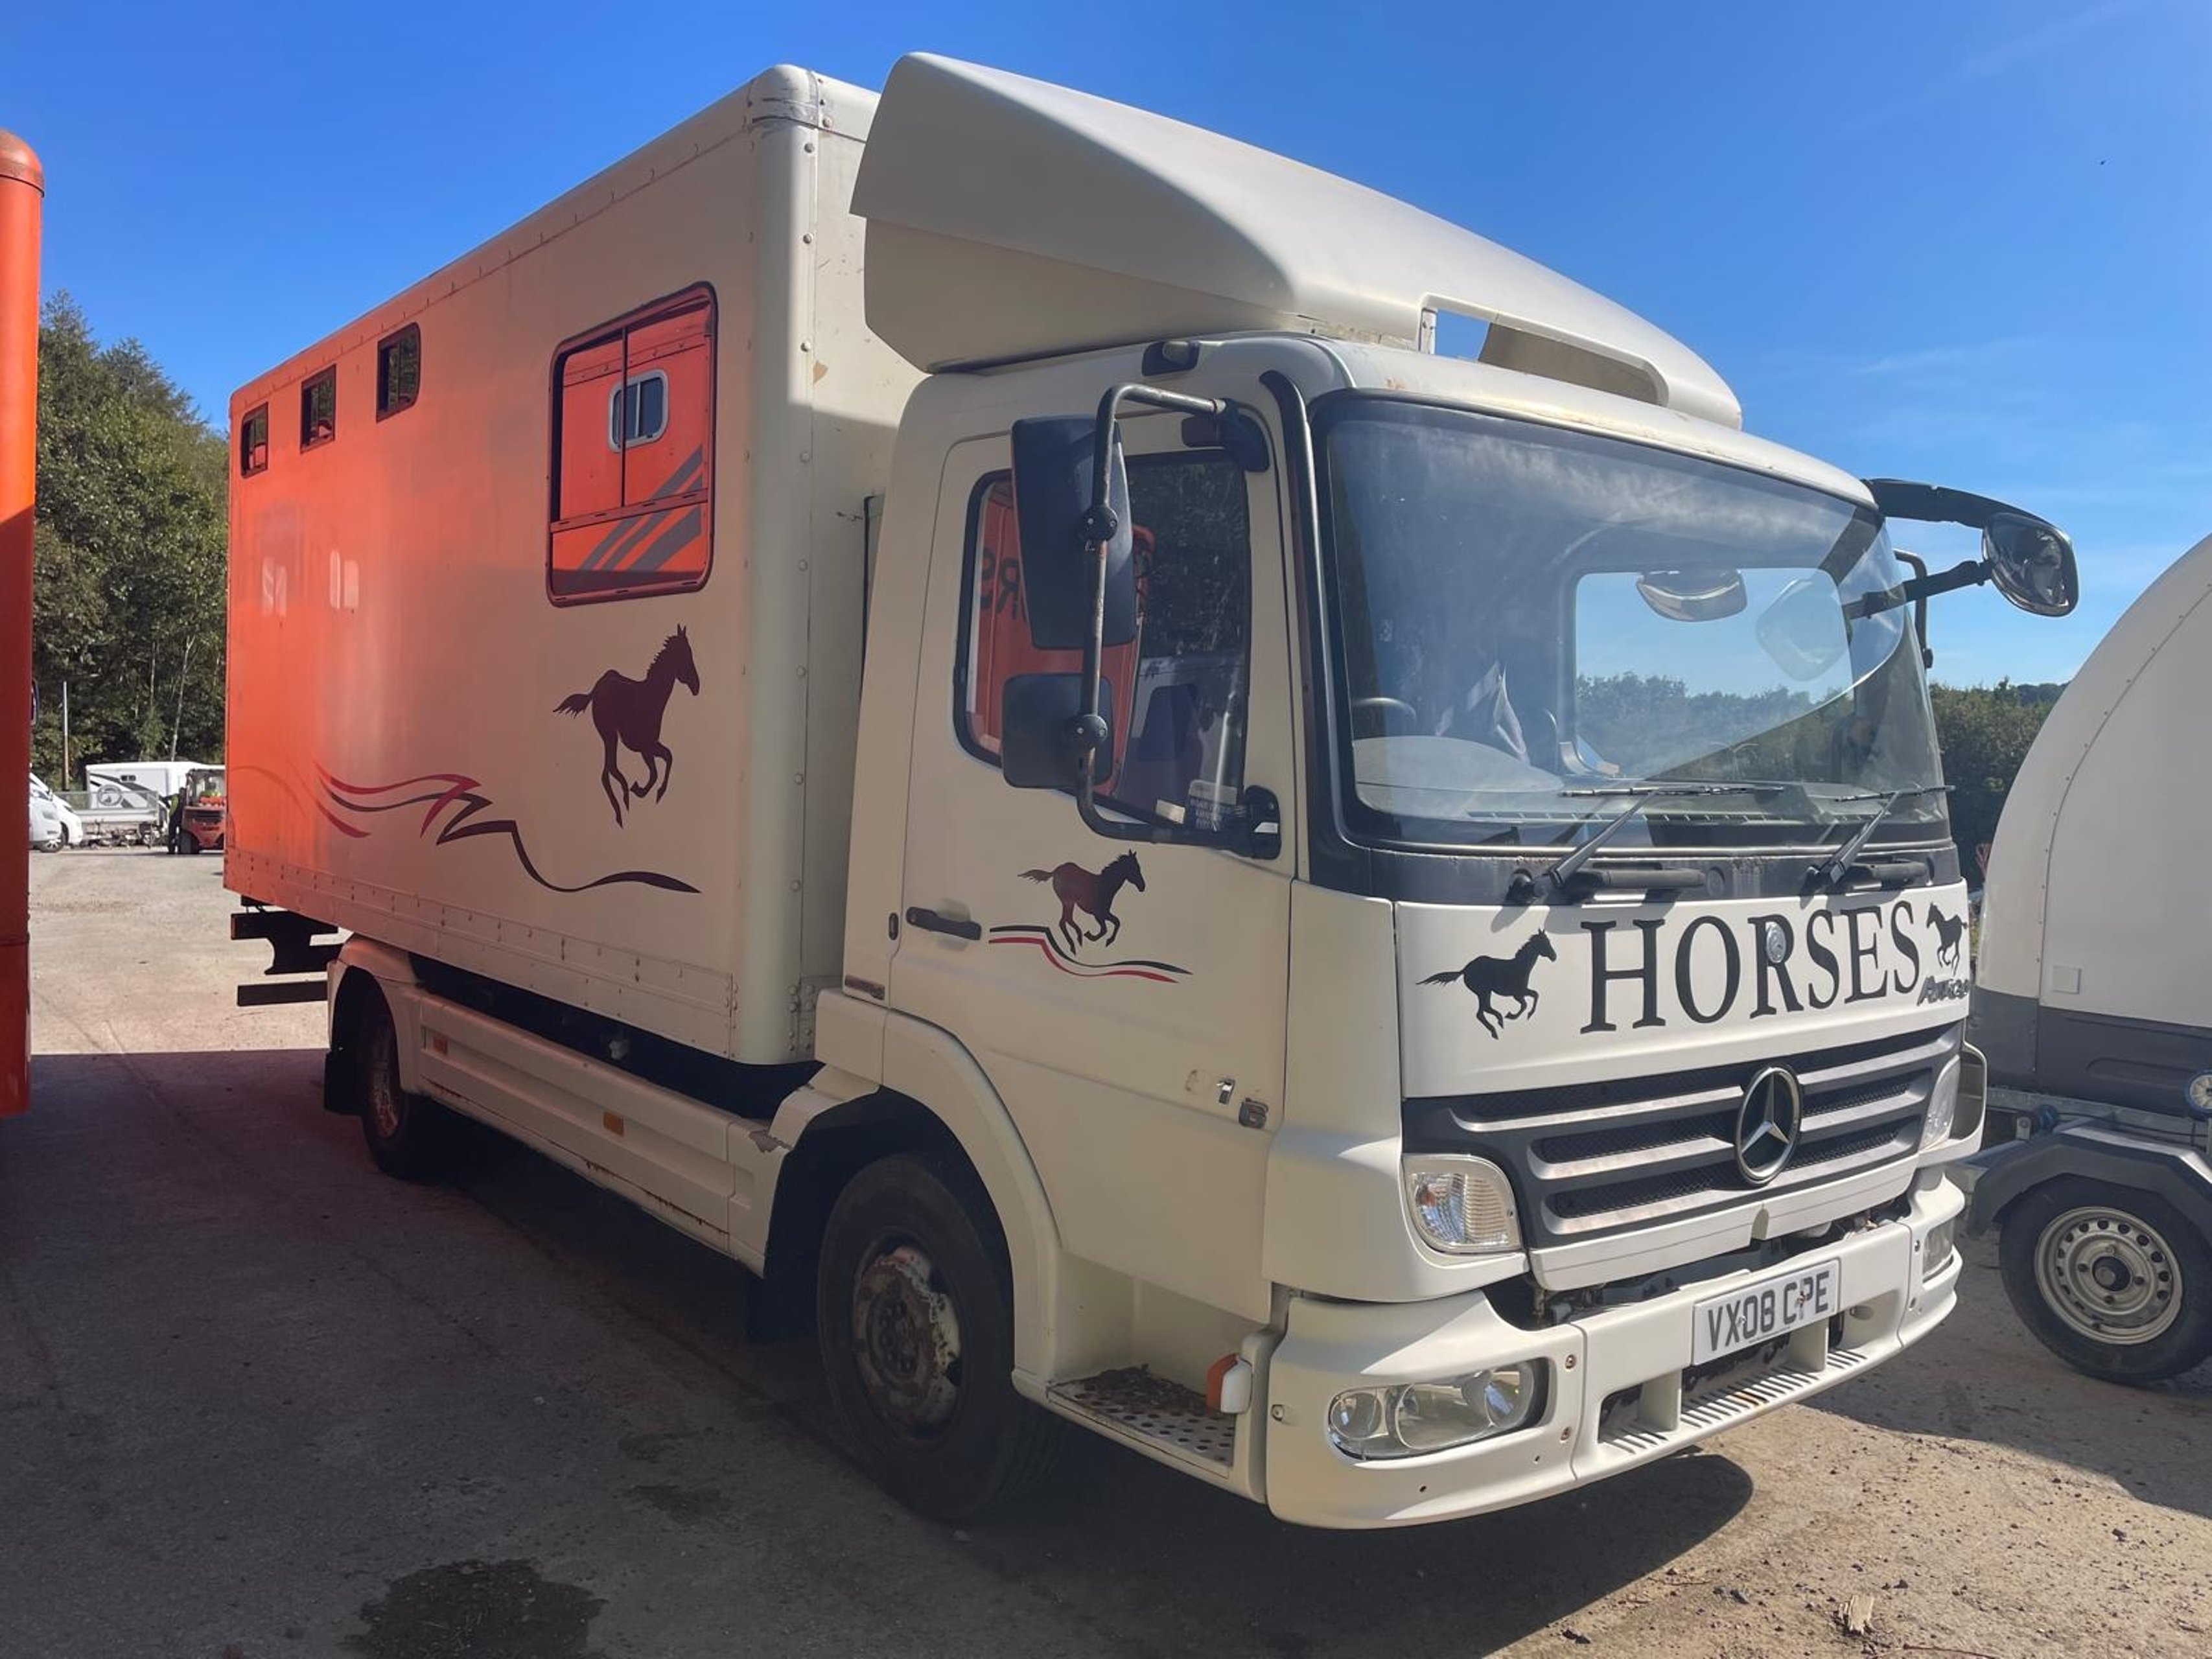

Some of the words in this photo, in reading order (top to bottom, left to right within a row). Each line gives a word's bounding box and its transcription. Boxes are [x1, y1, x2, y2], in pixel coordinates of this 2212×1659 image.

[1580, 900, 1920, 1035] HORSES
[1708, 1290, 1775, 1351] VX08
[1783, 1271, 1830, 1325] CPE
